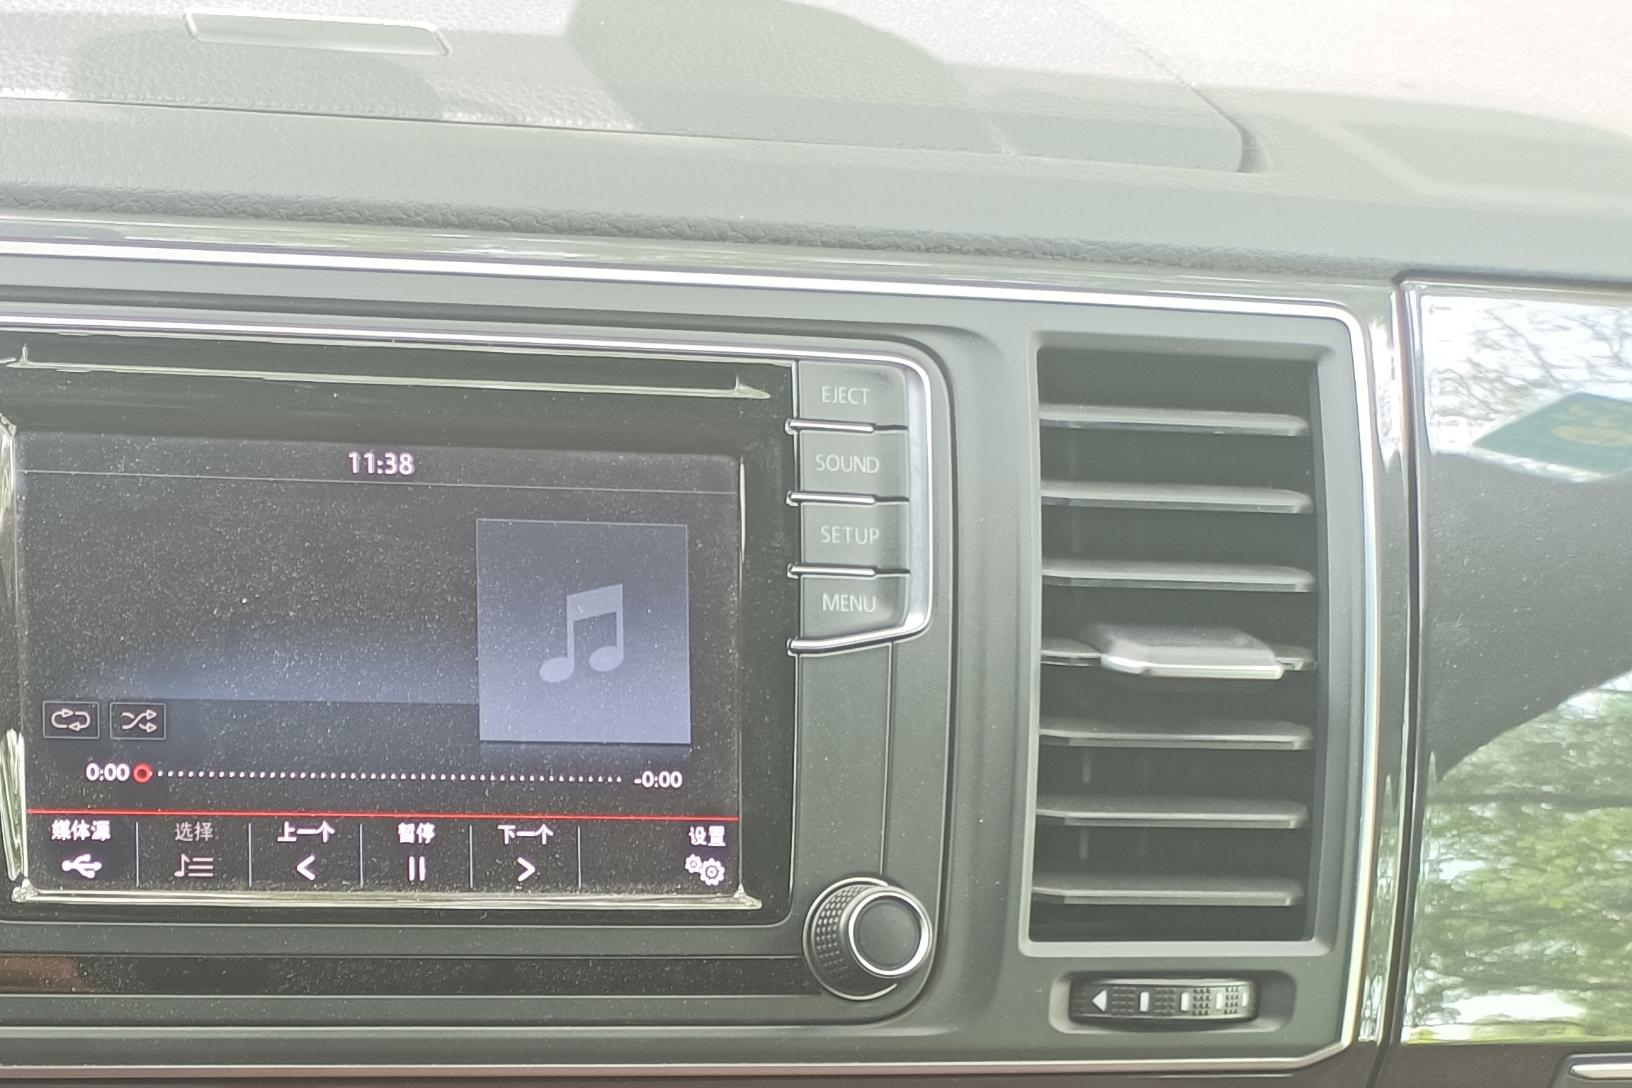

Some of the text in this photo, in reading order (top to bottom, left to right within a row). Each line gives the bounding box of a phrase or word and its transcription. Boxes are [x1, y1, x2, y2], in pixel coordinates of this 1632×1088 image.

[821, 386, 870, 405] EJECT
[348, 451, 415, 475] 11:38
[815, 454, 880, 474] SOUND
[820, 525, 880, 545] SETUP
[822, 593, 877, 613] MENU
[85, 762, 130, 782] 0:00
[634, 770, 683, 789] -0:00
[51, 819, 111, 842] 媒体源
[174, 821, 214, 842] 选择
[277, 821, 336, 843] 上一个
[397, 822, 436, 844] 暂停
[498, 824, 554, 845] 下一个
[689, 825, 726, 847] 设置
